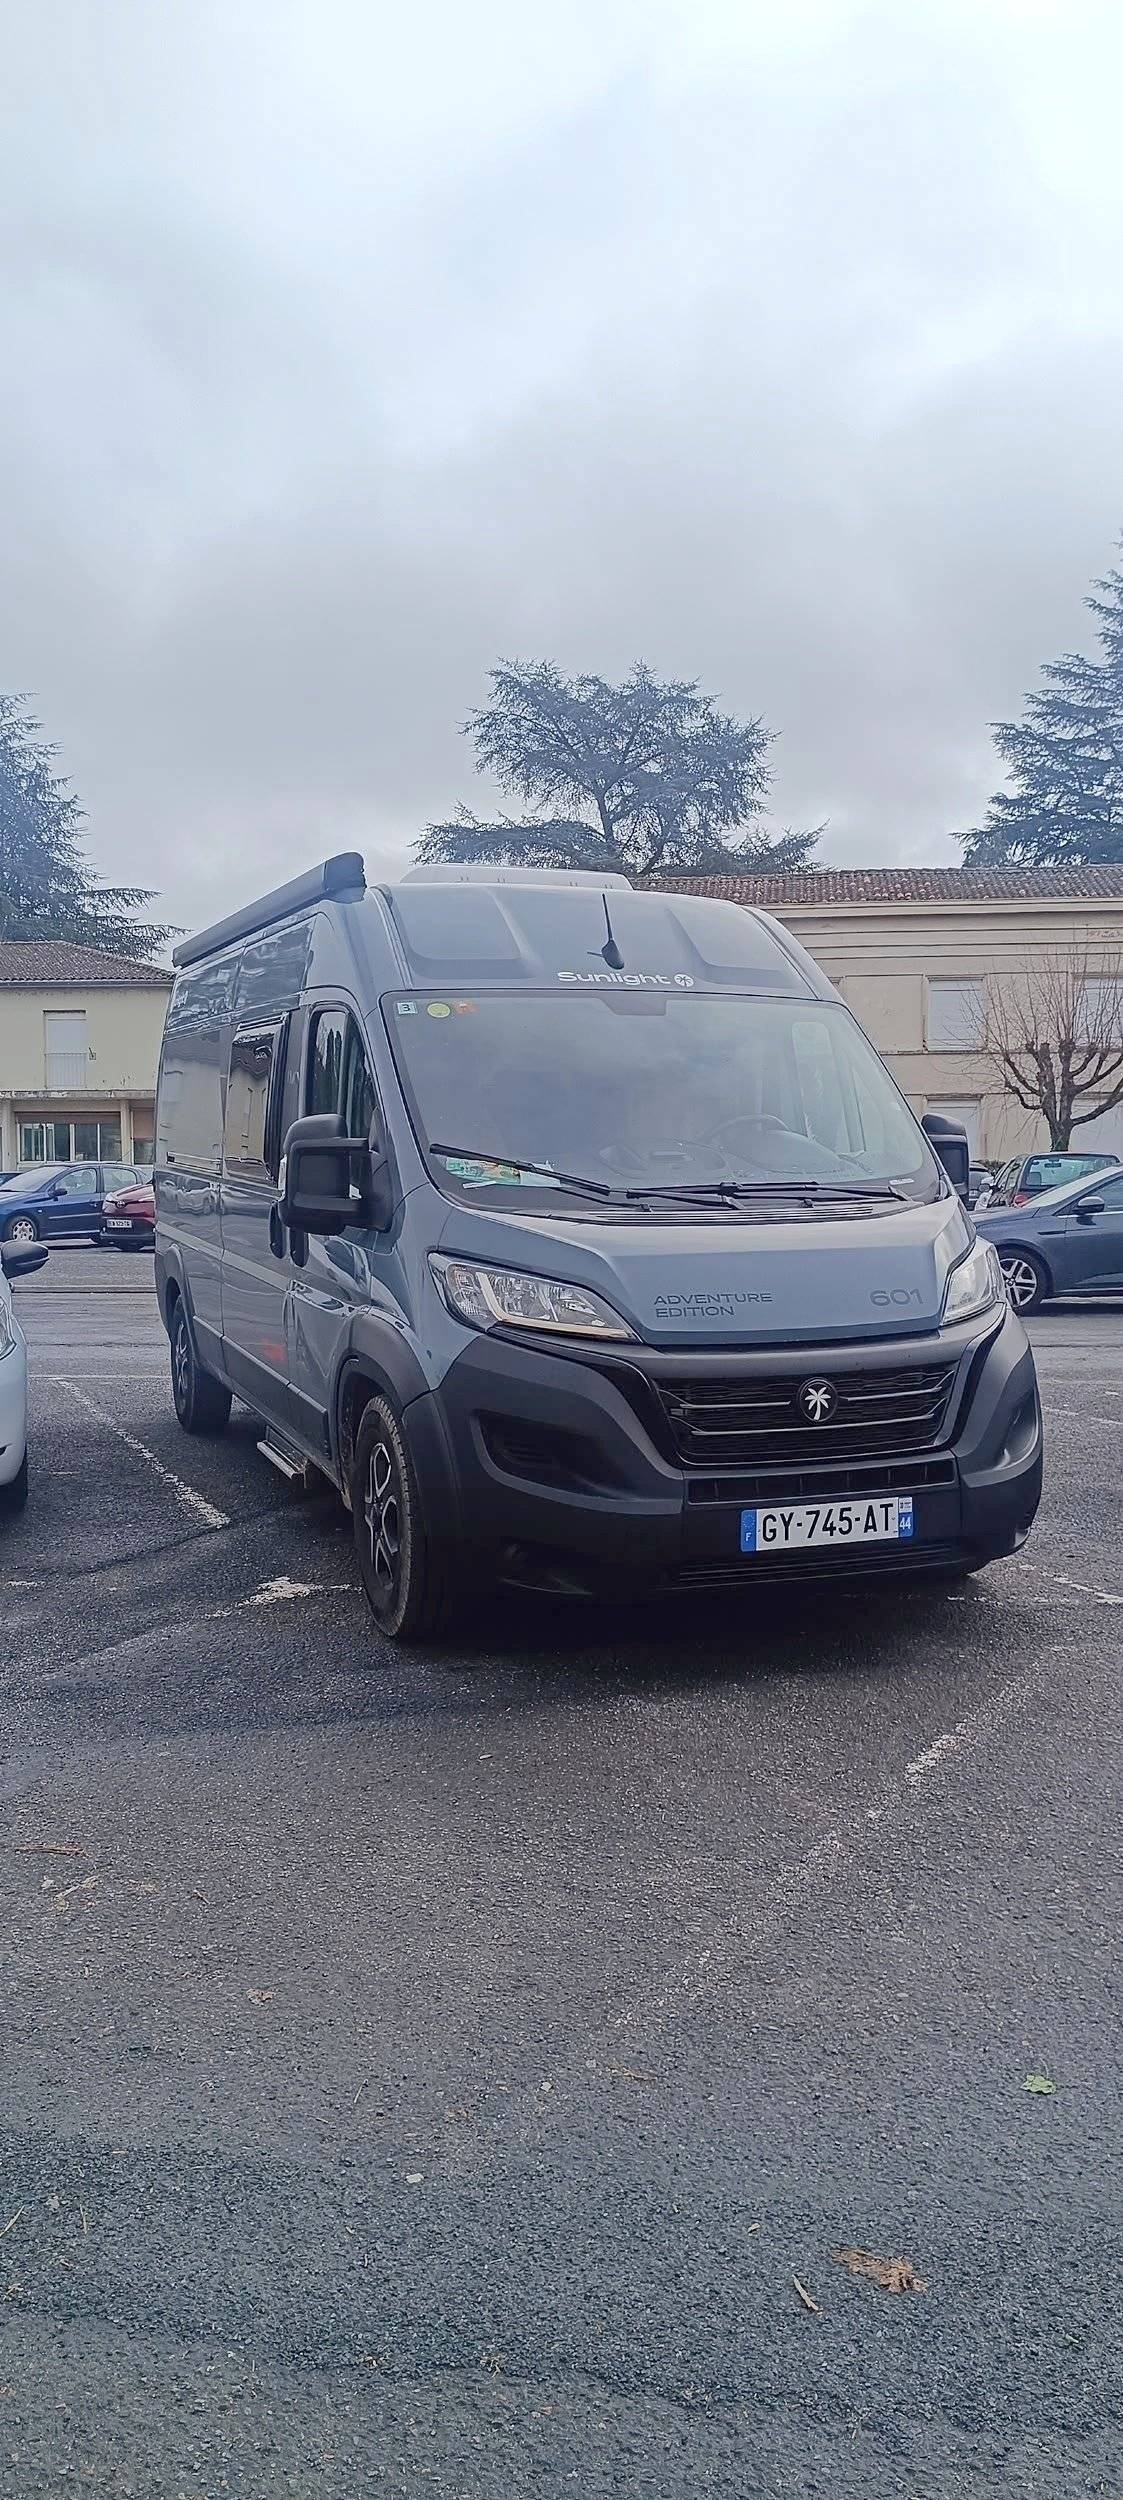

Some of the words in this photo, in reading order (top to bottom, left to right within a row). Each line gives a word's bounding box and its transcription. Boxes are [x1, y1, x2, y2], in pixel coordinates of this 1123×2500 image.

[557, 971, 672, 986] Sunlight
[653, 1293, 773, 1305] ADVENTURE
[870, 1288, 923, 1306] 601
[655, 1306, 735, 1318] EDITION
[762, 1503, 894, 1542] GY-745-AT
[899, 1516, 912, 1530] 44
[745, 1532, 752, 1542] F
